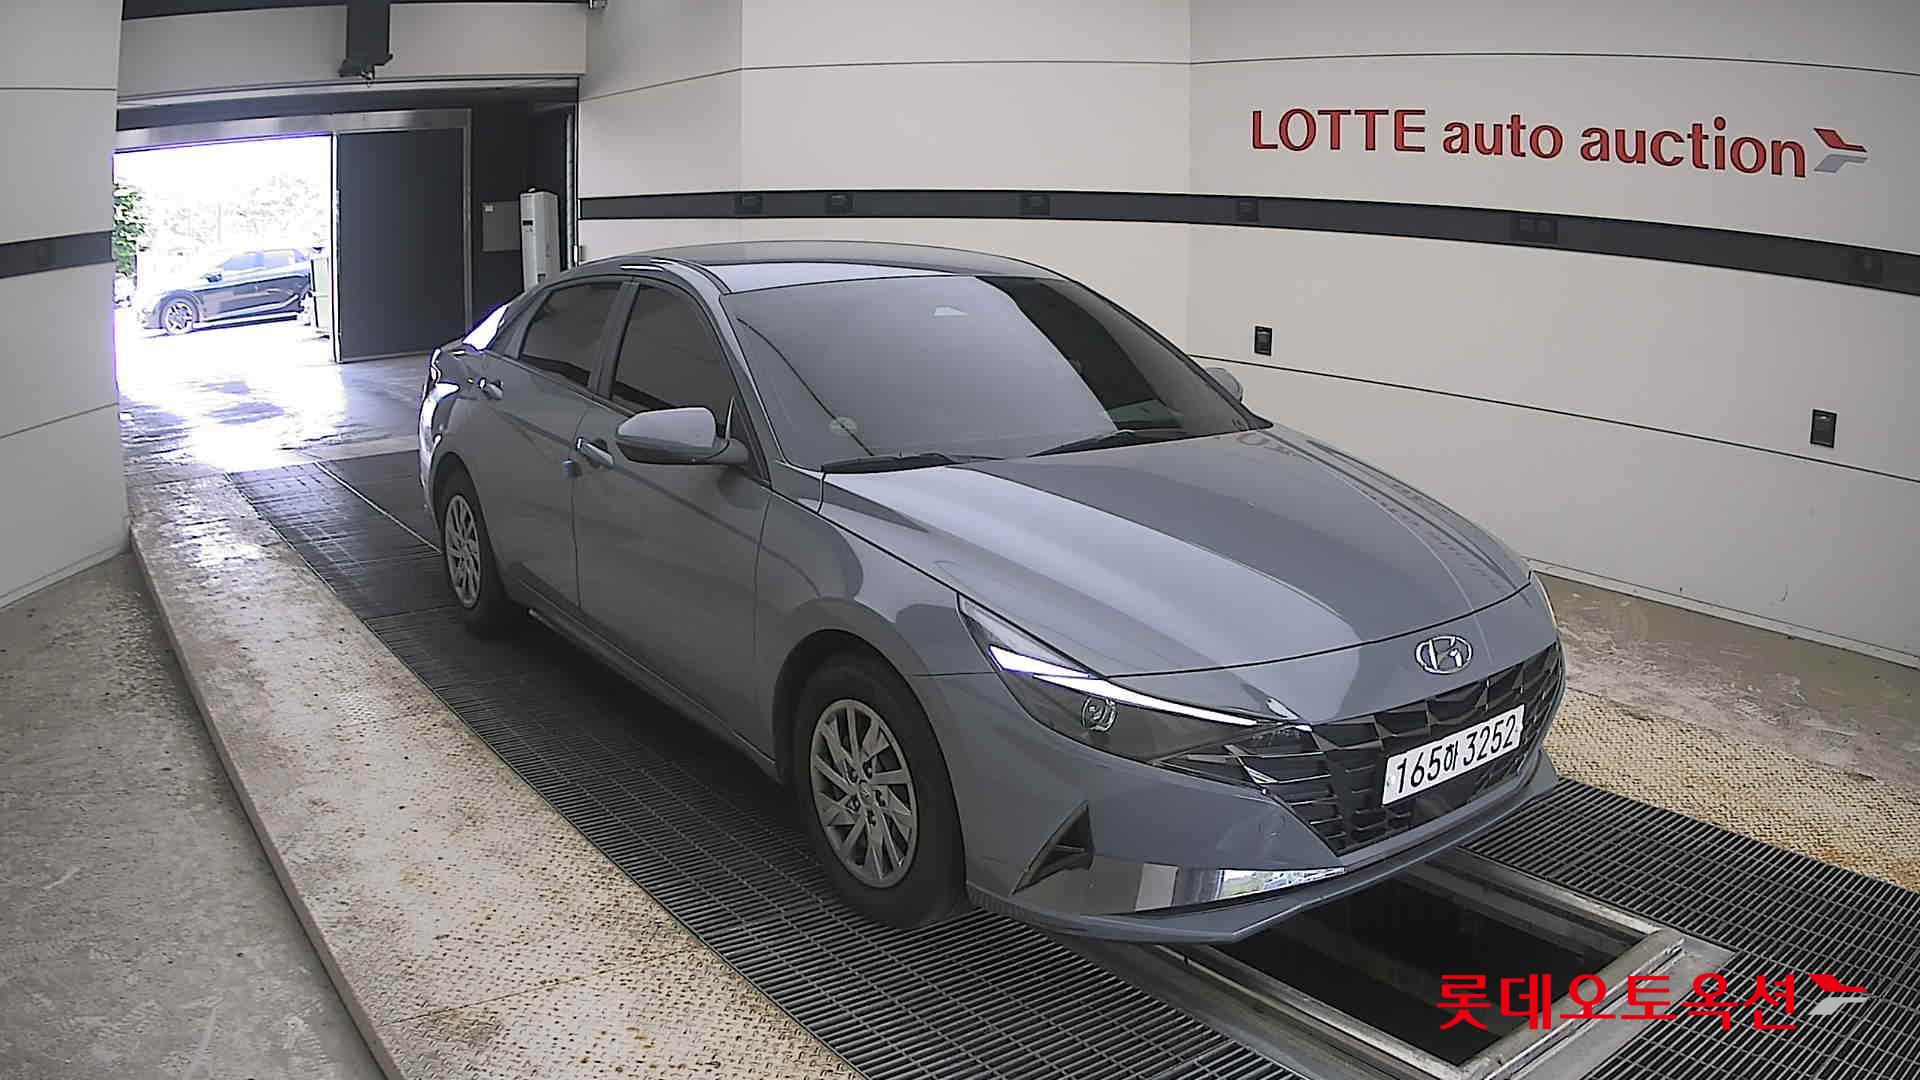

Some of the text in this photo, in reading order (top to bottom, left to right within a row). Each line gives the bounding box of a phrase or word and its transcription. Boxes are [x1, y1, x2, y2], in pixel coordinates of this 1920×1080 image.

[1251, 107, 1807, 178] LOTTE auto auction
[1396, 714, 1517, 794] 165하 3252
